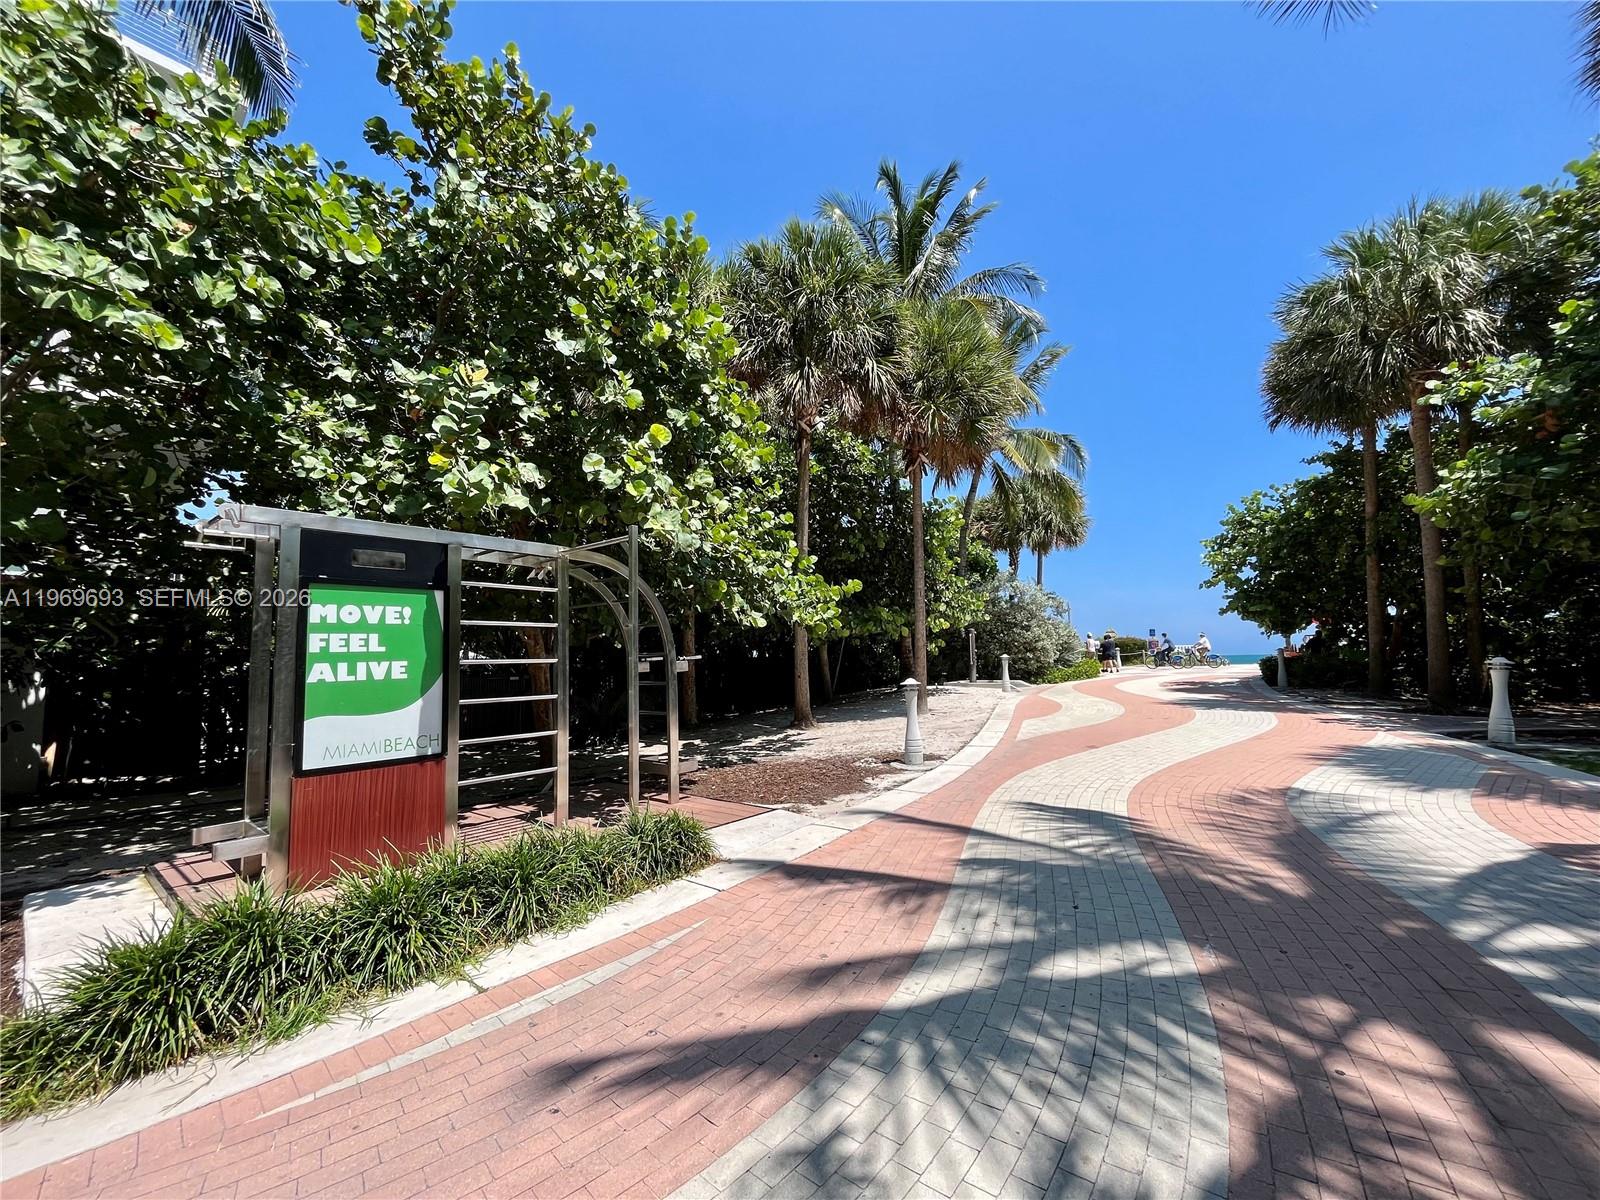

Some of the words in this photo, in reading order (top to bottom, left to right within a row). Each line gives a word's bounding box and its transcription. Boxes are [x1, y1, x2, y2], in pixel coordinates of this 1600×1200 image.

[309, 603, 412, 625] MOVE!
[308, 633, 387, 653] FEEL
[306, 660, 408, 683] ALIVE
